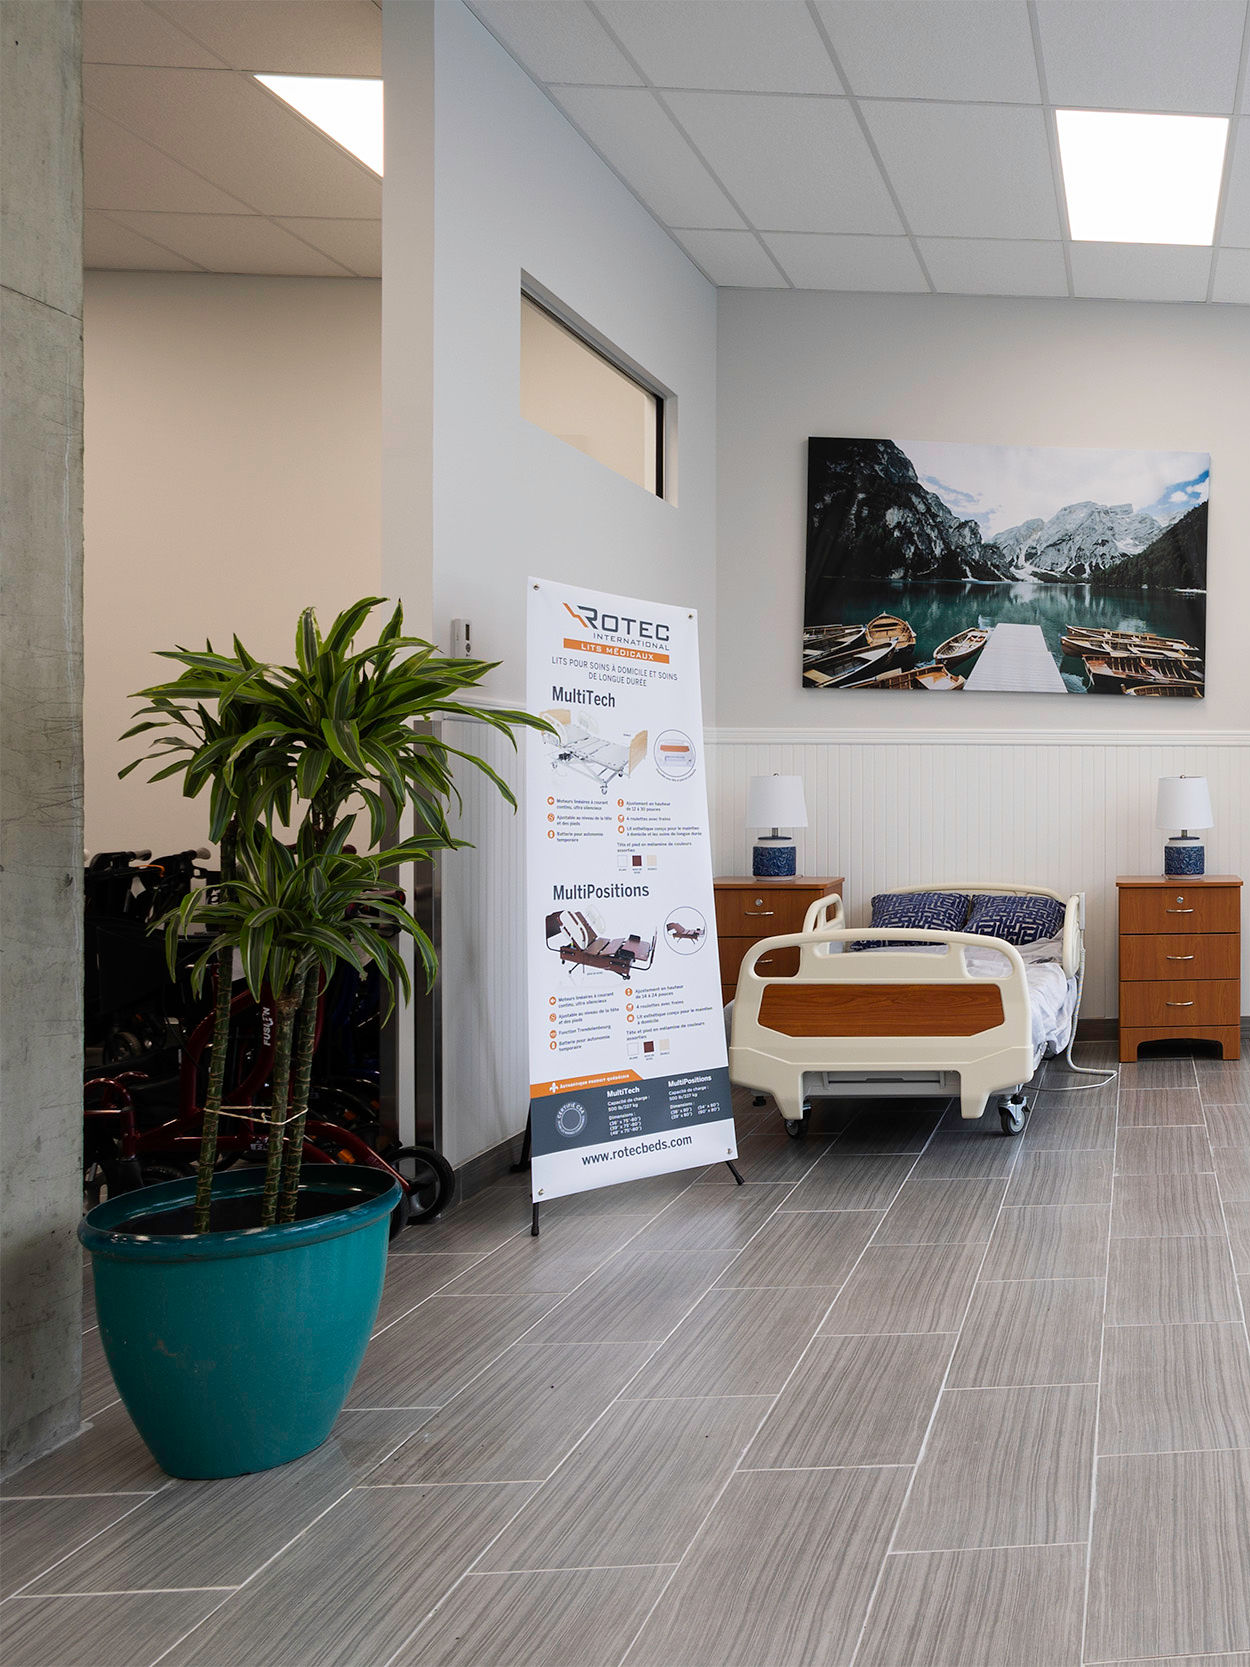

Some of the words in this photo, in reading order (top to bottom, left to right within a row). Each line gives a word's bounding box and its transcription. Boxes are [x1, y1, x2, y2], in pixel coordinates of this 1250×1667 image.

[577, 605, 670, 642] ROTEC
[593, 633, 670, 651] INTERNATIONAL
[580, 642, 602, 653] LITS
[606, 647, 655, 661] MÉDICAUX
[552, 656, 567, 666] LITS
[569, 658, 588, 669] POUR
[590, 661, 609, 672] SOINS
[611, 662, 616, 672] À
[617, 665, 648, 678] DOMICILE
[649, 669, 657, 678] ET
[658, 671, 678, 681] SOINS
[588, 671, 598, 680] DE
[599, 672, 625, 685] LONGUE
[627, 676, 647, 687] DURÉE
[552, 686, 616, 708] MultiTech
[553, 884, 649, 901] MultiPositions
[668, 1075, 712, 1087] MultiPositions
[607, 1086, 640, 1097] MultiTech
[581, 1134, 692, 1166] www.rotecbeds.com
